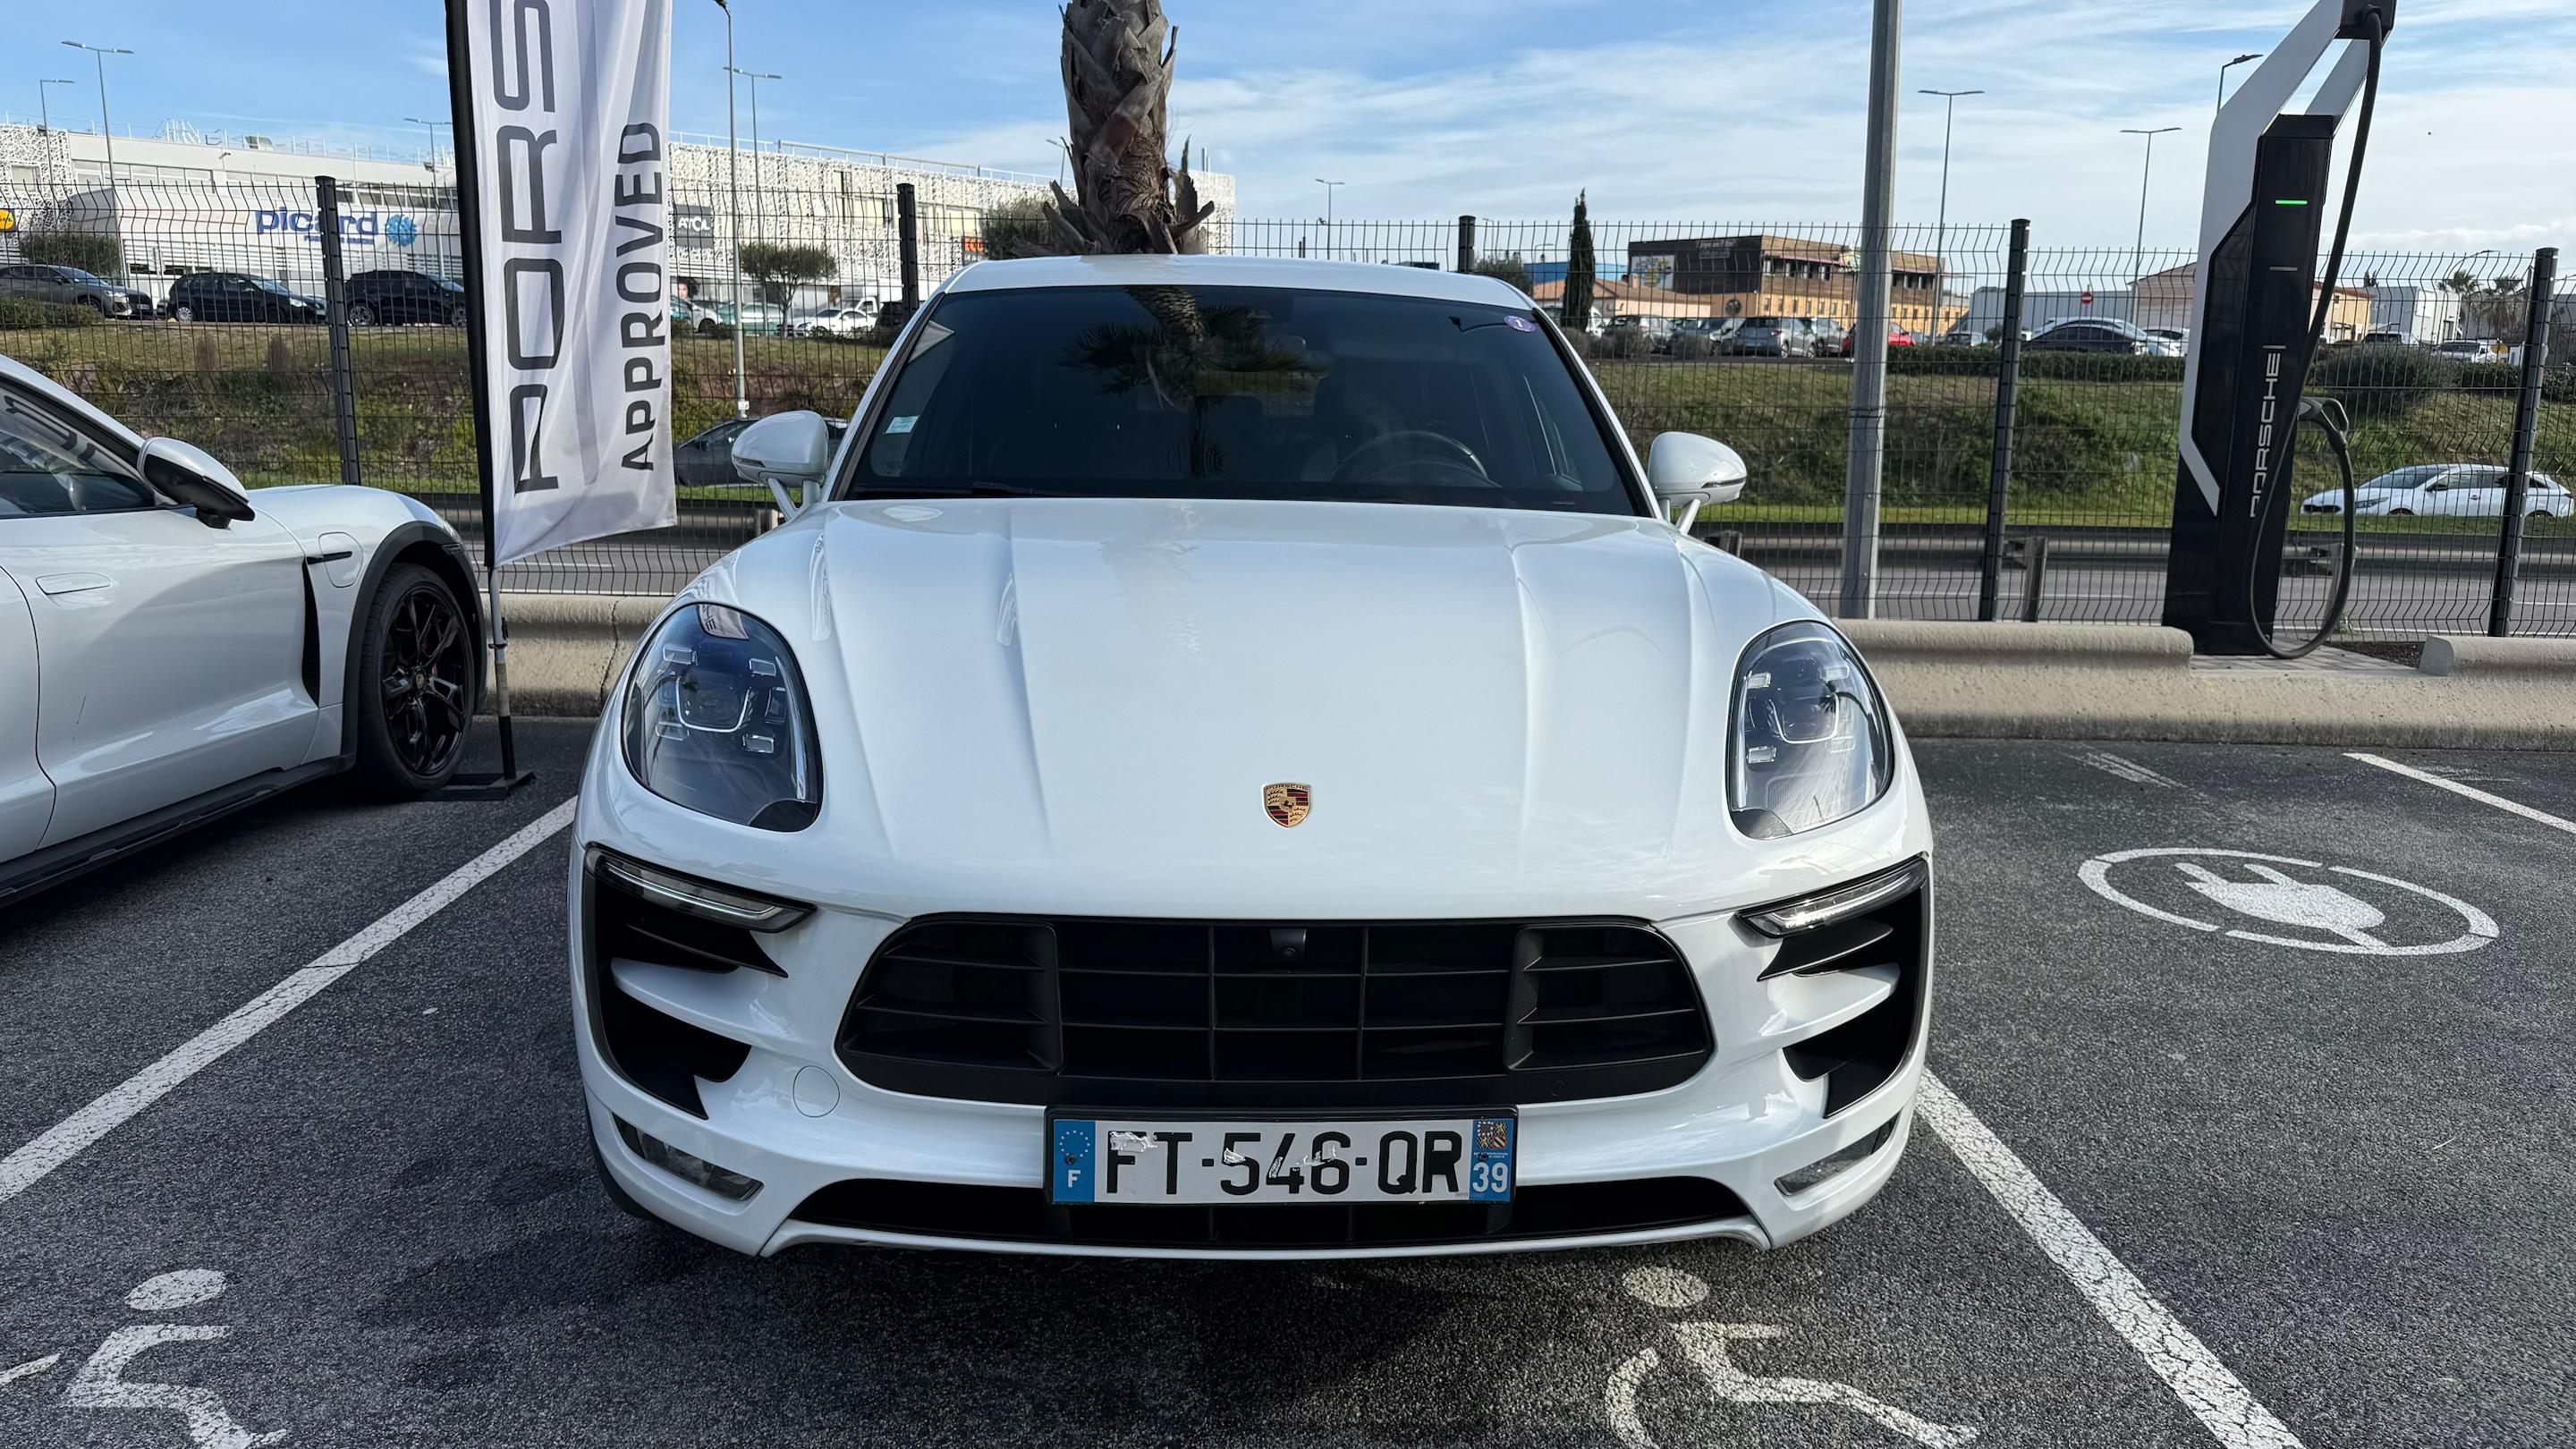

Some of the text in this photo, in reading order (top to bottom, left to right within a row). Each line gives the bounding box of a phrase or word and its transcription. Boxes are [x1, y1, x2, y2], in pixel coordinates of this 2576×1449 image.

[258, 207, 377, 235] picrd
[614, 122, 666, 472] APPROVED
[1067, 1131, 1508, 1196] F FT-546-QR 39
